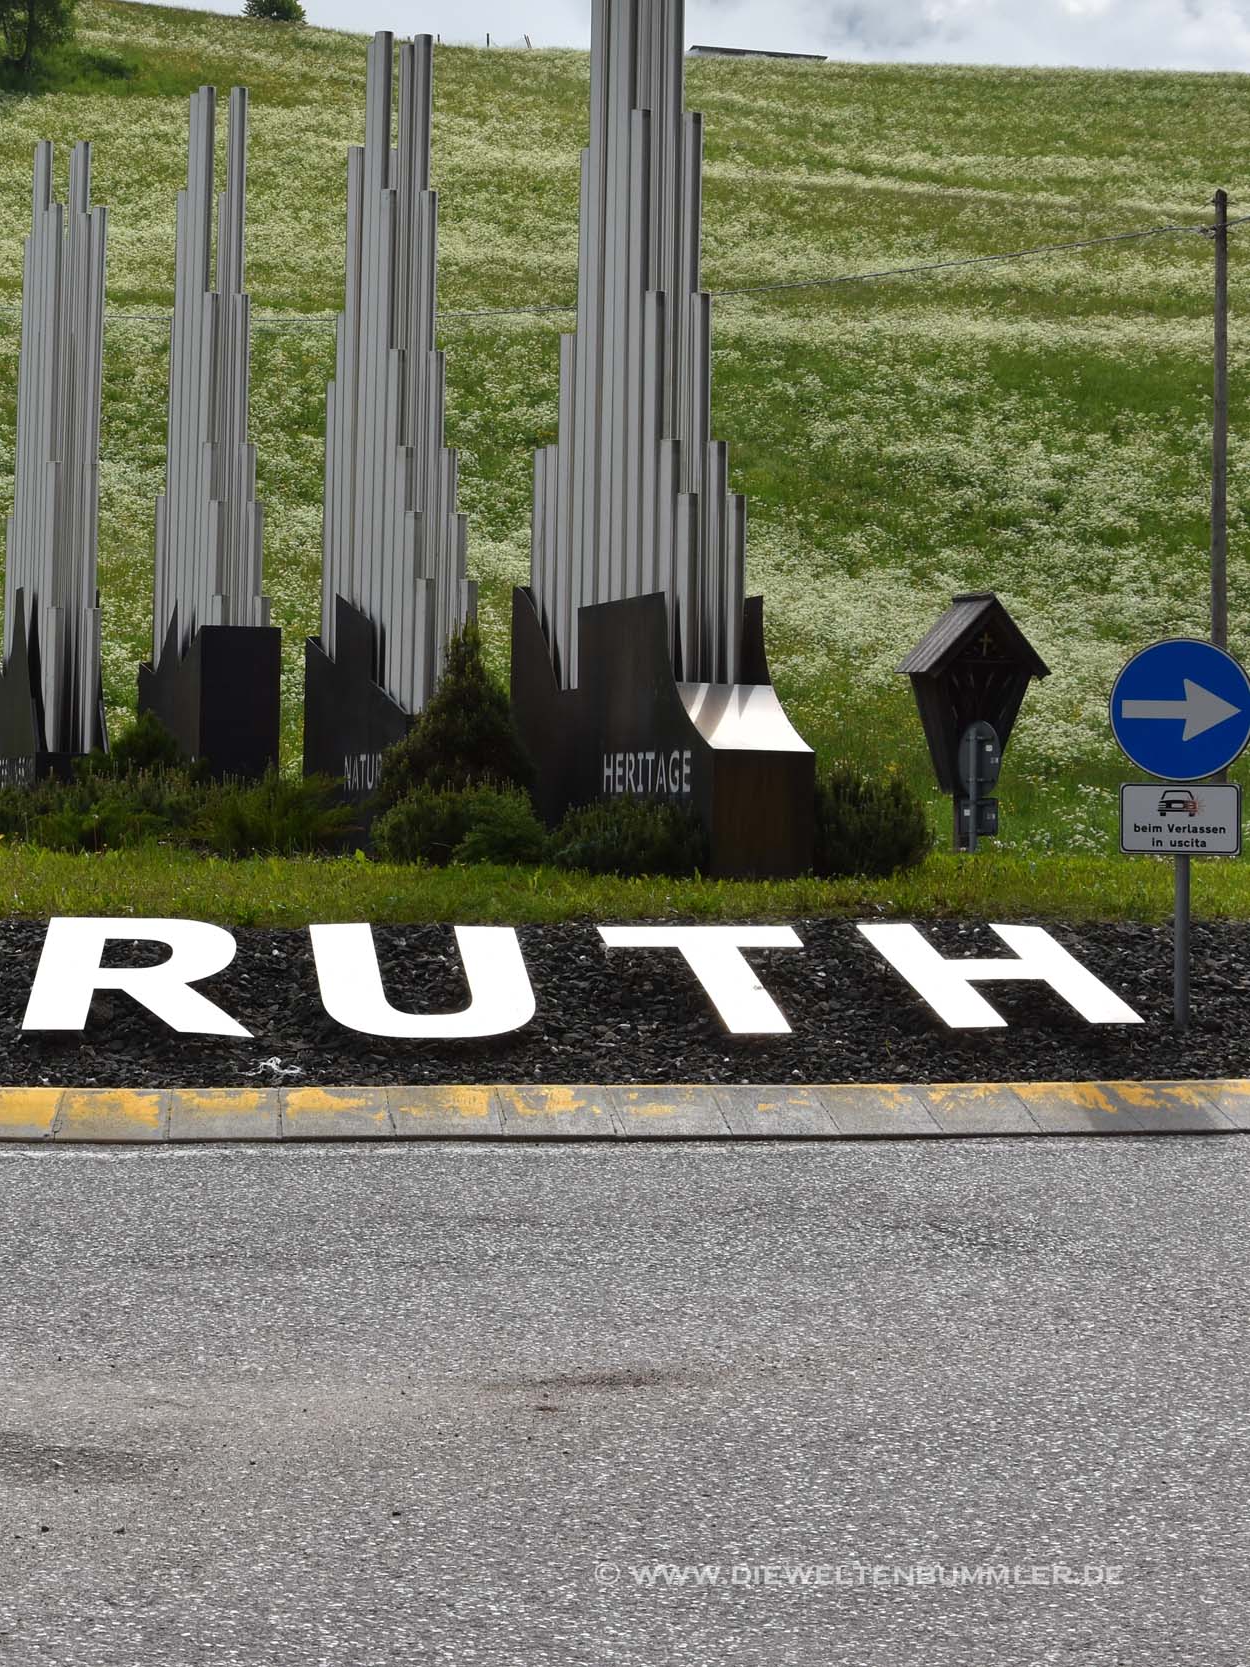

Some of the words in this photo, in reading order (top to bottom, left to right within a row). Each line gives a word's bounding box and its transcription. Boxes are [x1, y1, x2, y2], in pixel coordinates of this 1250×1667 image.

[603, 750, 692, 793] HERITAGE
[1134, 824, 1162, 833] beim
[1168, 824, 1226, 834] Verlassen
[1152, 838, 1163, 847] in
[1170, 839, 1207, 848] uscita
